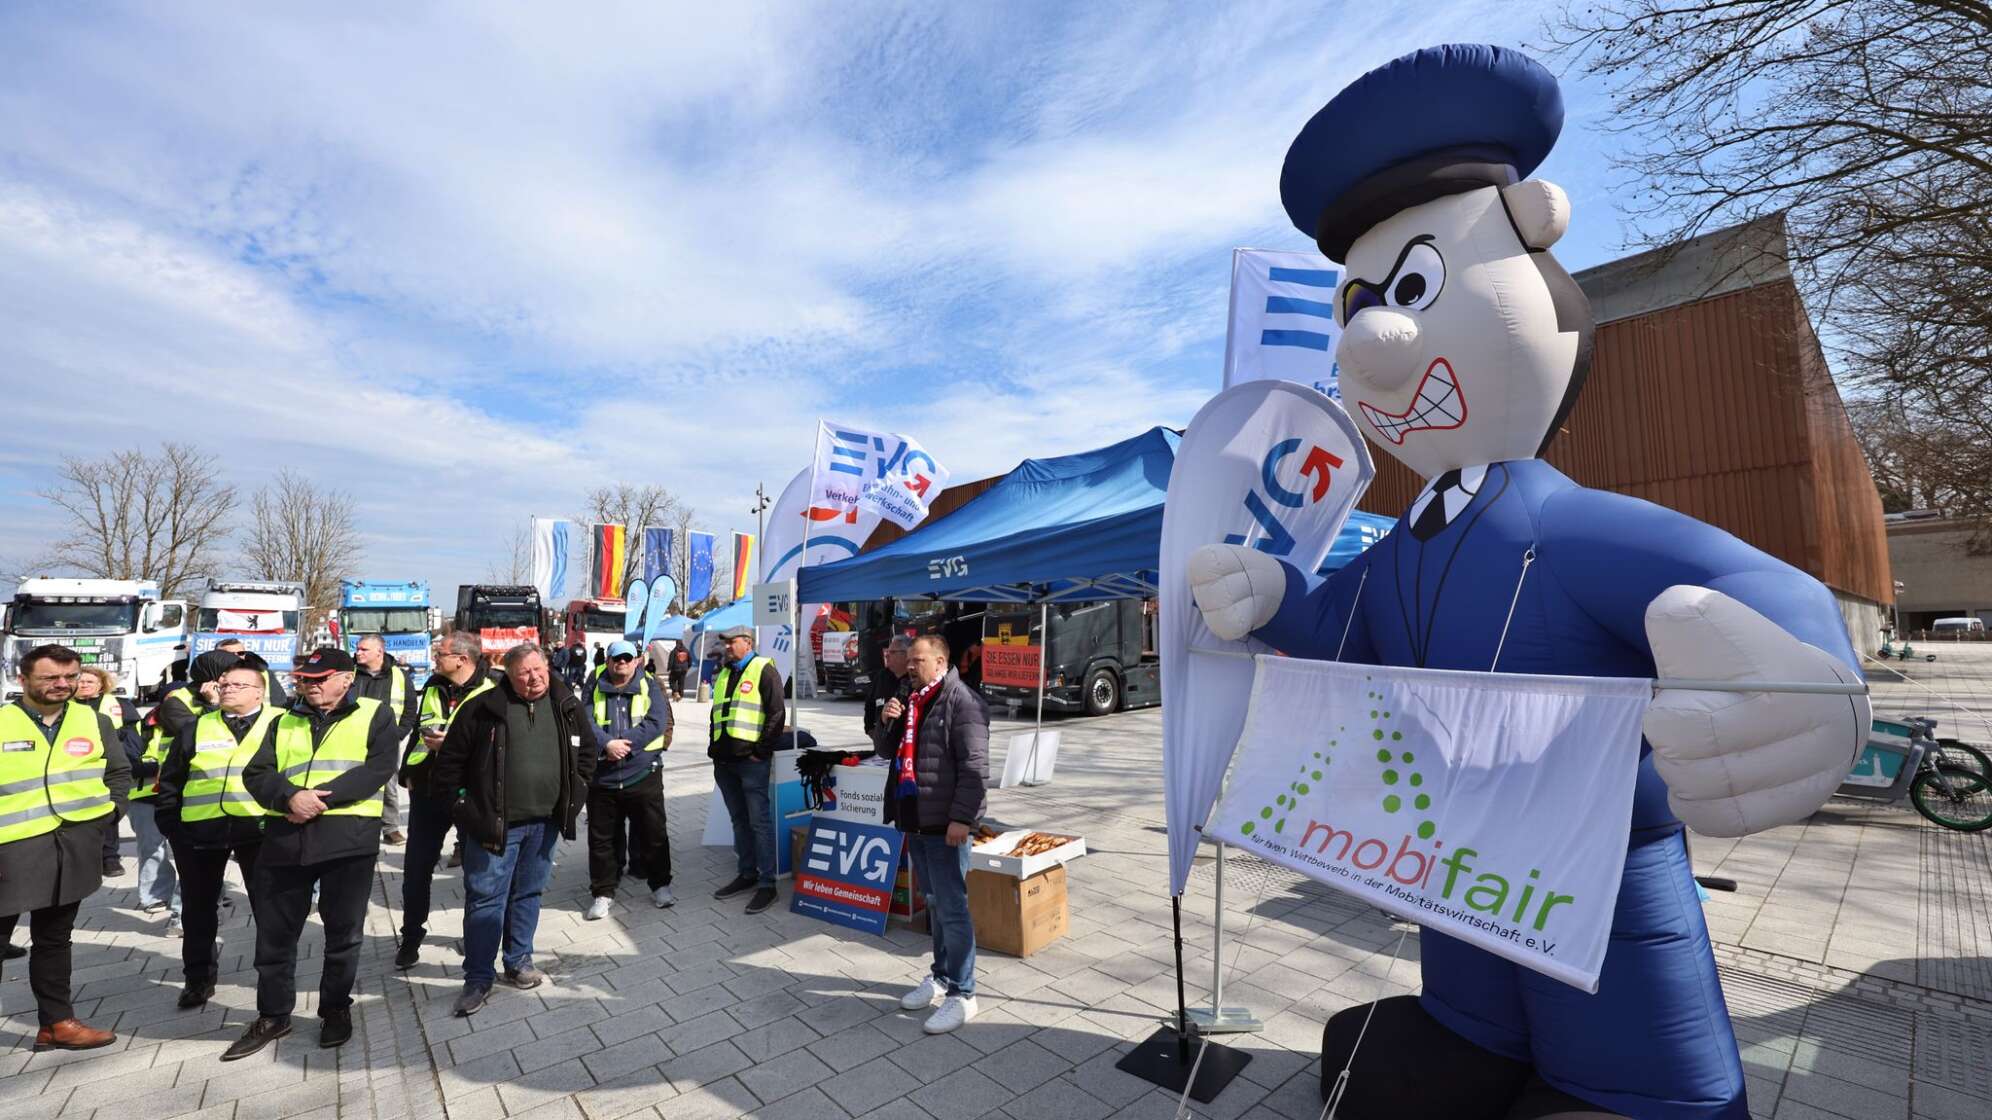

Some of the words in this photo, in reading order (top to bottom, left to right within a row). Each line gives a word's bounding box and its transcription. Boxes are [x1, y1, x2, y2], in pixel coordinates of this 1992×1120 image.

[829, 430, 936, 499] EVG
[928, 555, 968, 579] EVG
[840, 789, 860, 801] Fonds
[861, 792, 884, 802] sozial
[840, 802, 877, 816] Sicherung
[808, 828, 891, 883] EVG
[1299, 819, 1575, 931] mobifair
[1350, 872, 1361, 881] in
[1364, 877, 1384, 890] der
[803, 880, 814, 890] Wir
[815, 882, 833, 894] leben
[834, 887, 881, 906] Gemeinschaft
